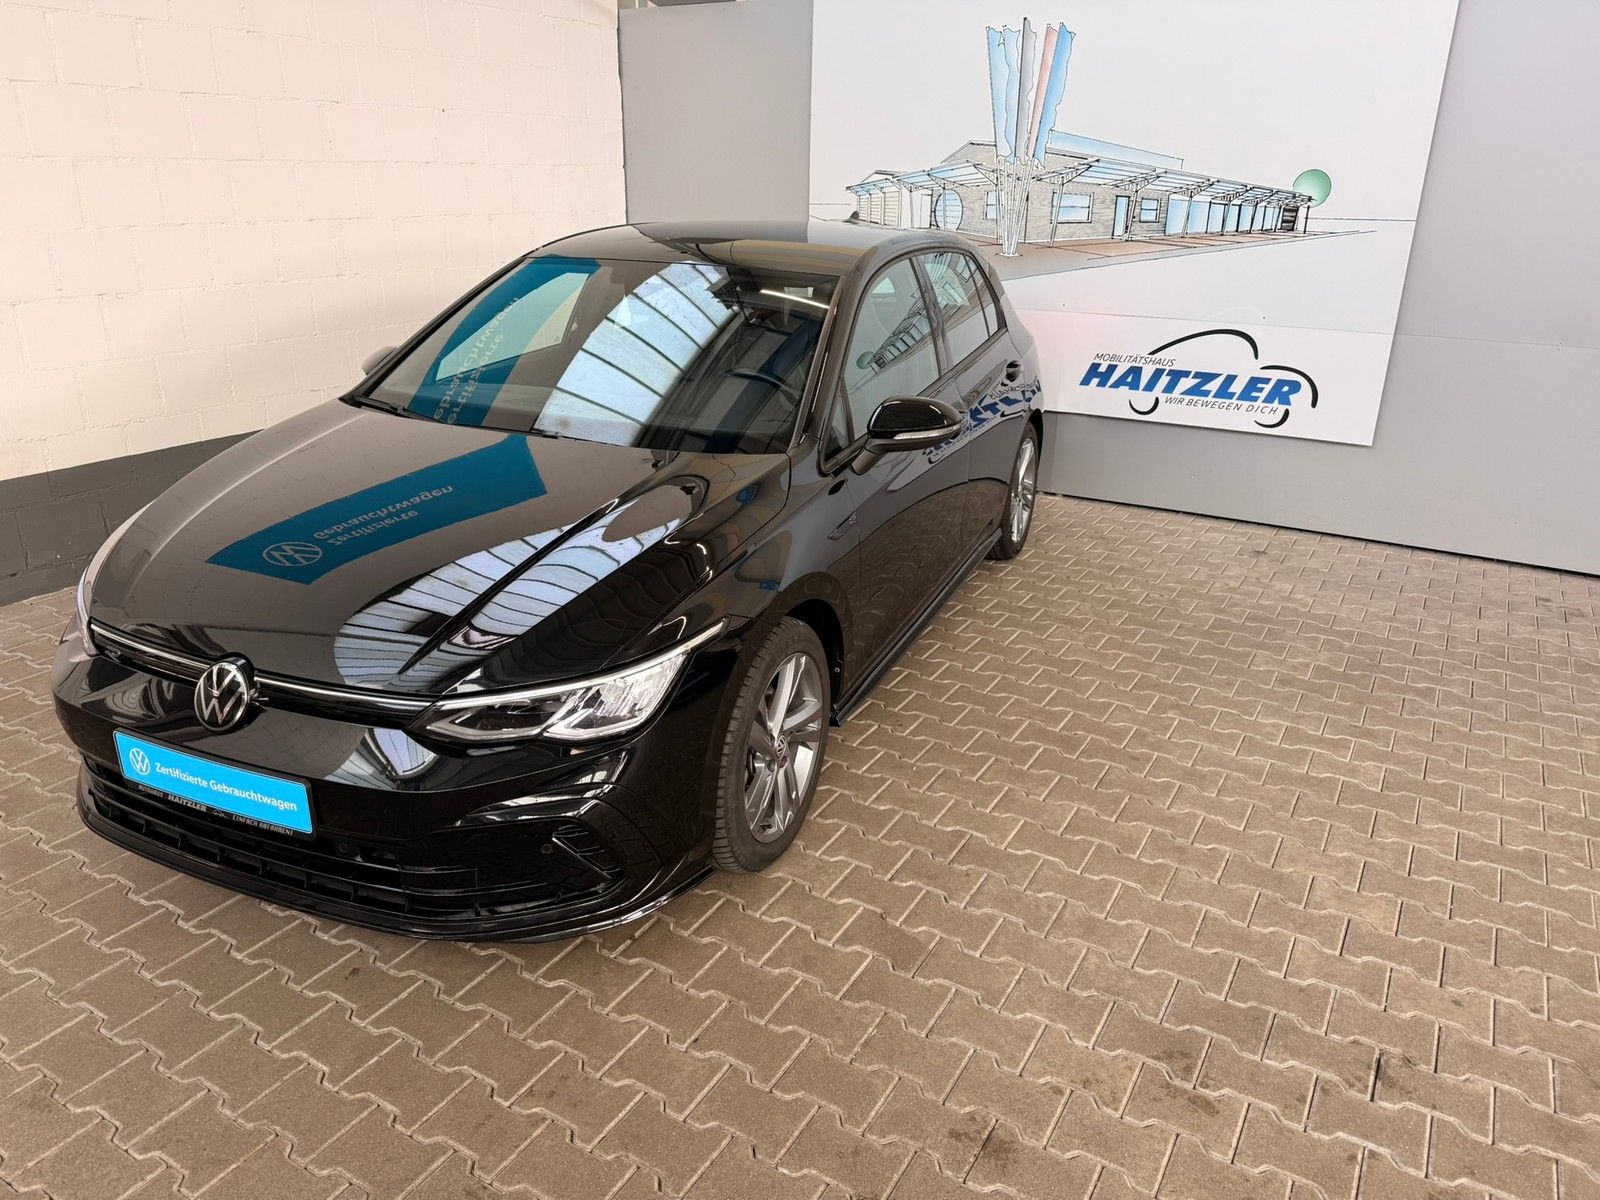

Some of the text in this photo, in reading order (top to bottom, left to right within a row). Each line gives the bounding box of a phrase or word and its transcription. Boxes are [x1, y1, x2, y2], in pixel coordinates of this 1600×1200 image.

[1093, 353, 1176, 367] MOBILITÄTSHAUS
[1079, 362, 1302, 406] HAITZLER
[1164, 396, 1279, 415] WIR BEWEGEN DICH
[154, 762, 298, 811] Zertifizierte Gebrauchtwagen
[167, 794, 207, 812] HAITZLER
